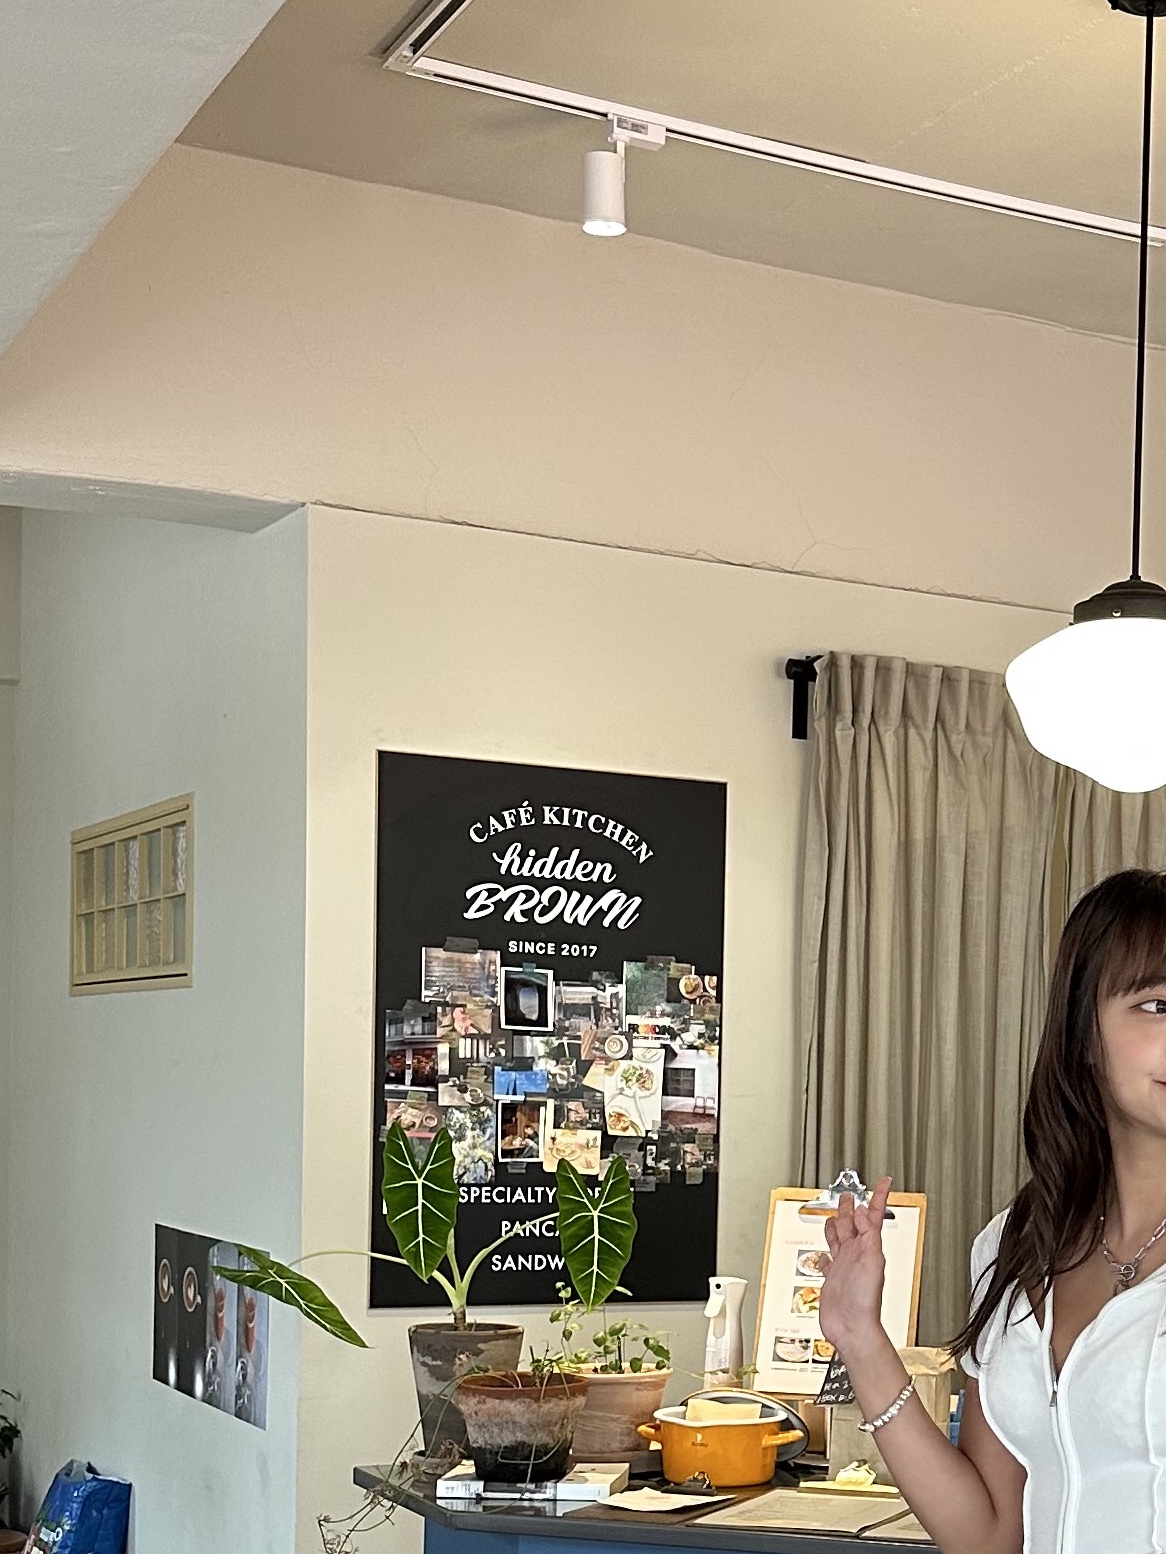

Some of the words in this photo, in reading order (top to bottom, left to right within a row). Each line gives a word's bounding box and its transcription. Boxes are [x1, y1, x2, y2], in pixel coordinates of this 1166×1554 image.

[468, 800, 536, 843] CAFÉ
[542, 805, 654, 865] KITCHEN
[491, 842, 617, 884] hidden
[462, 882, 643, 930] BROWN
[508, 940, 556, 955] SINCE
[560, 942, 598, 958] 2017
[458, 1186, 557, 1204] SPECIALTY
